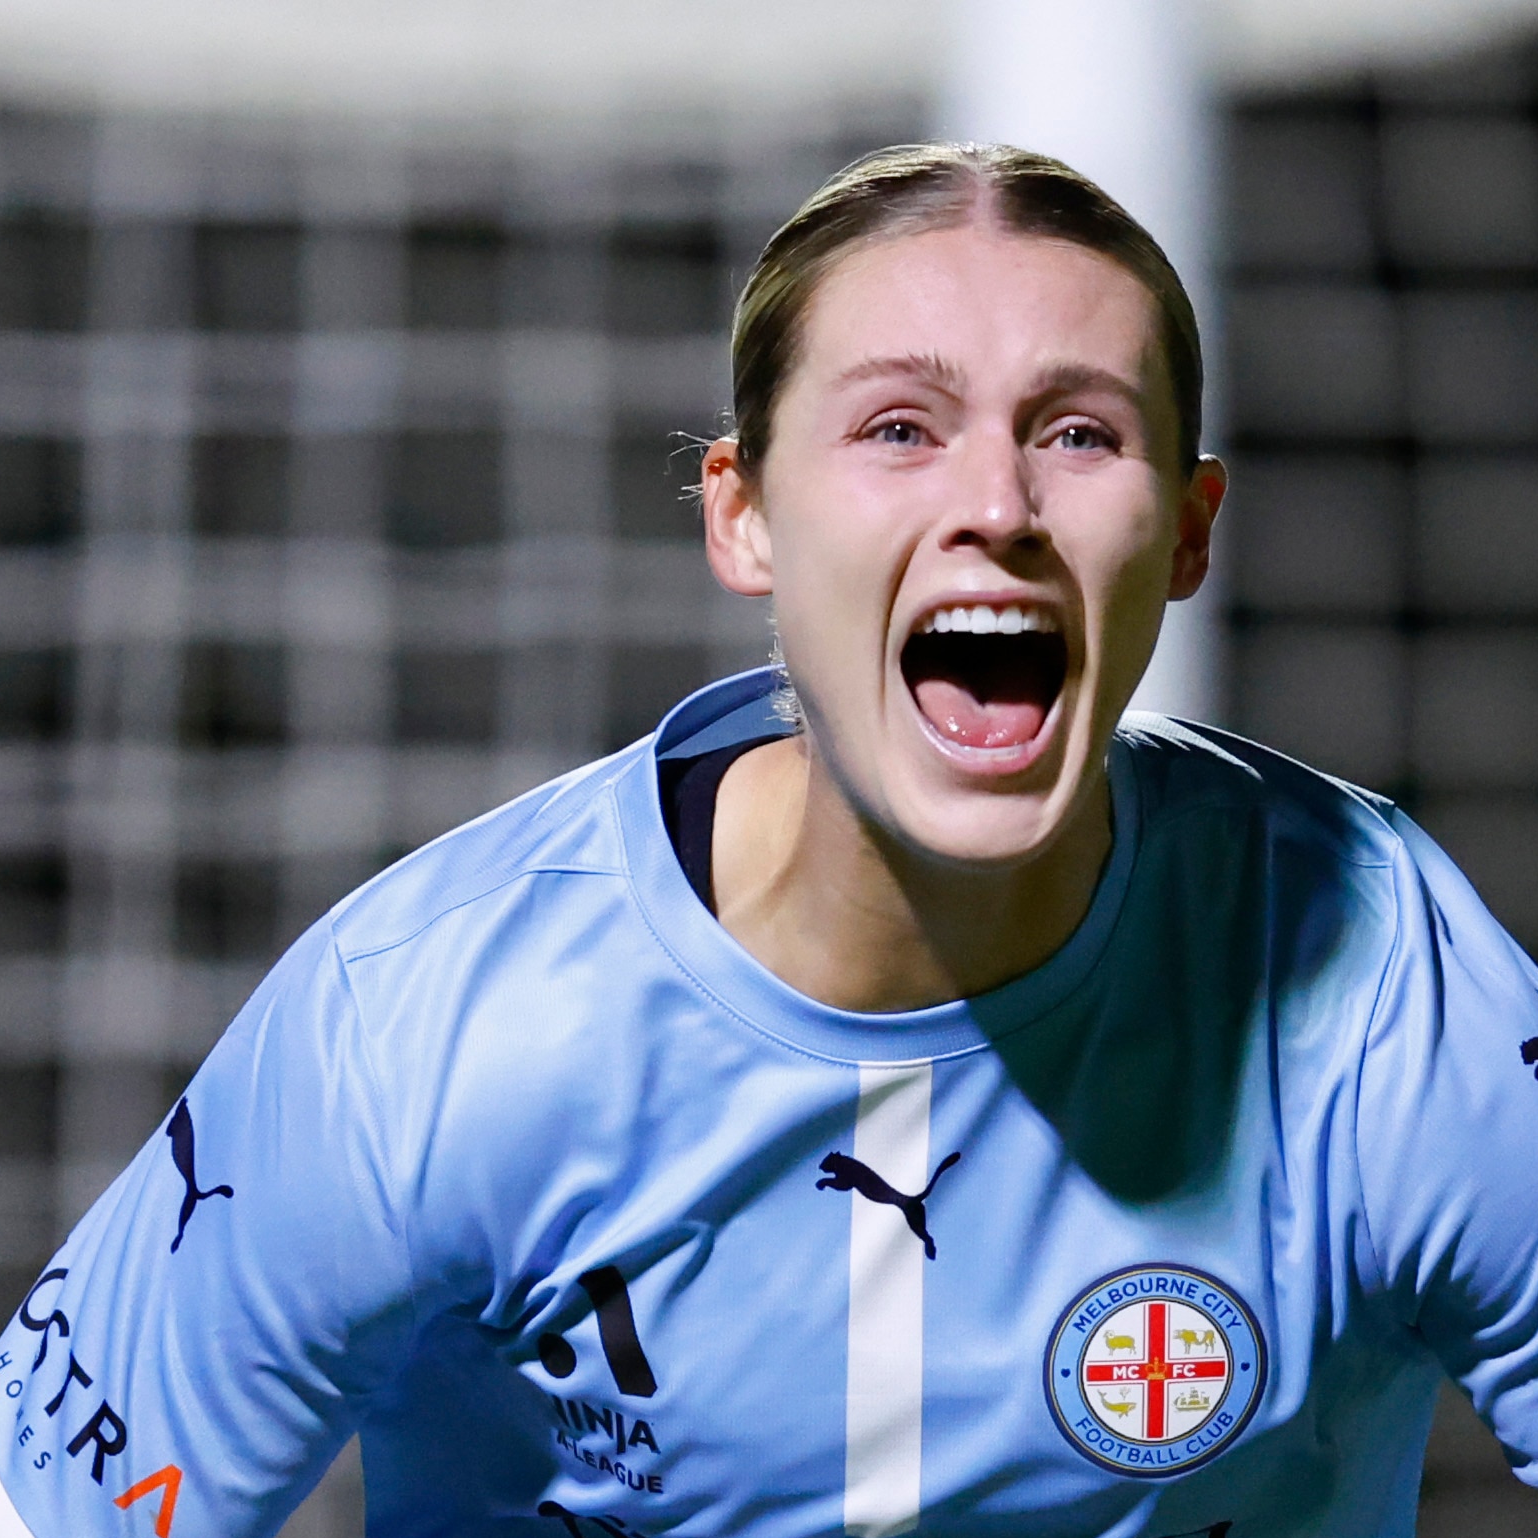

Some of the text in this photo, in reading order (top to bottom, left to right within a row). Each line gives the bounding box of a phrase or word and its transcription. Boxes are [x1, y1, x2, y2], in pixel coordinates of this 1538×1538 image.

[1073, 1277, 1242, 1333] MELBOURNE CITY
[1113, 1364, 1196, 1379] MC FC
[1075, 1412, 1234, 1465] FOOTBALL CLUB
